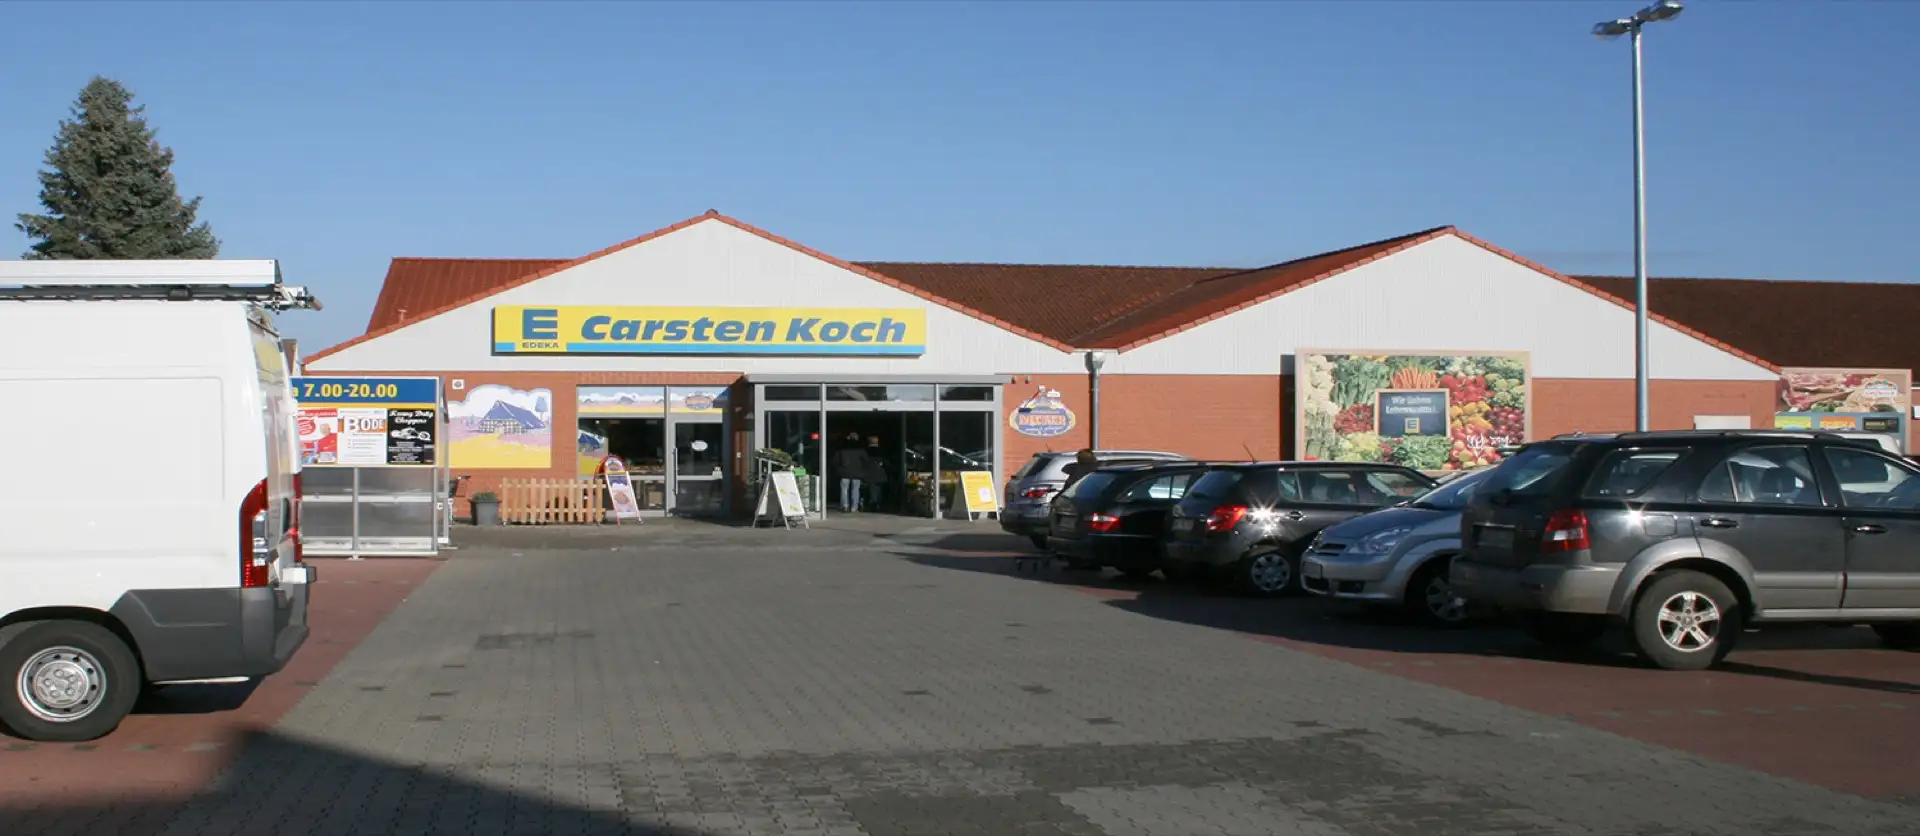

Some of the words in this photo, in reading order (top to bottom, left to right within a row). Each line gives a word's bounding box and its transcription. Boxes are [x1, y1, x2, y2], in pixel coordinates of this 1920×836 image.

[522, 309, 559, 340] E
[581, 315, 776, 342] Carsten
[785, 317, 907, 344] Koch
[521, 341, 560, 349] EDEKA
[304, 383, 398, 398] 7.00-20.00
[346, 416, 384, 431] BODE
